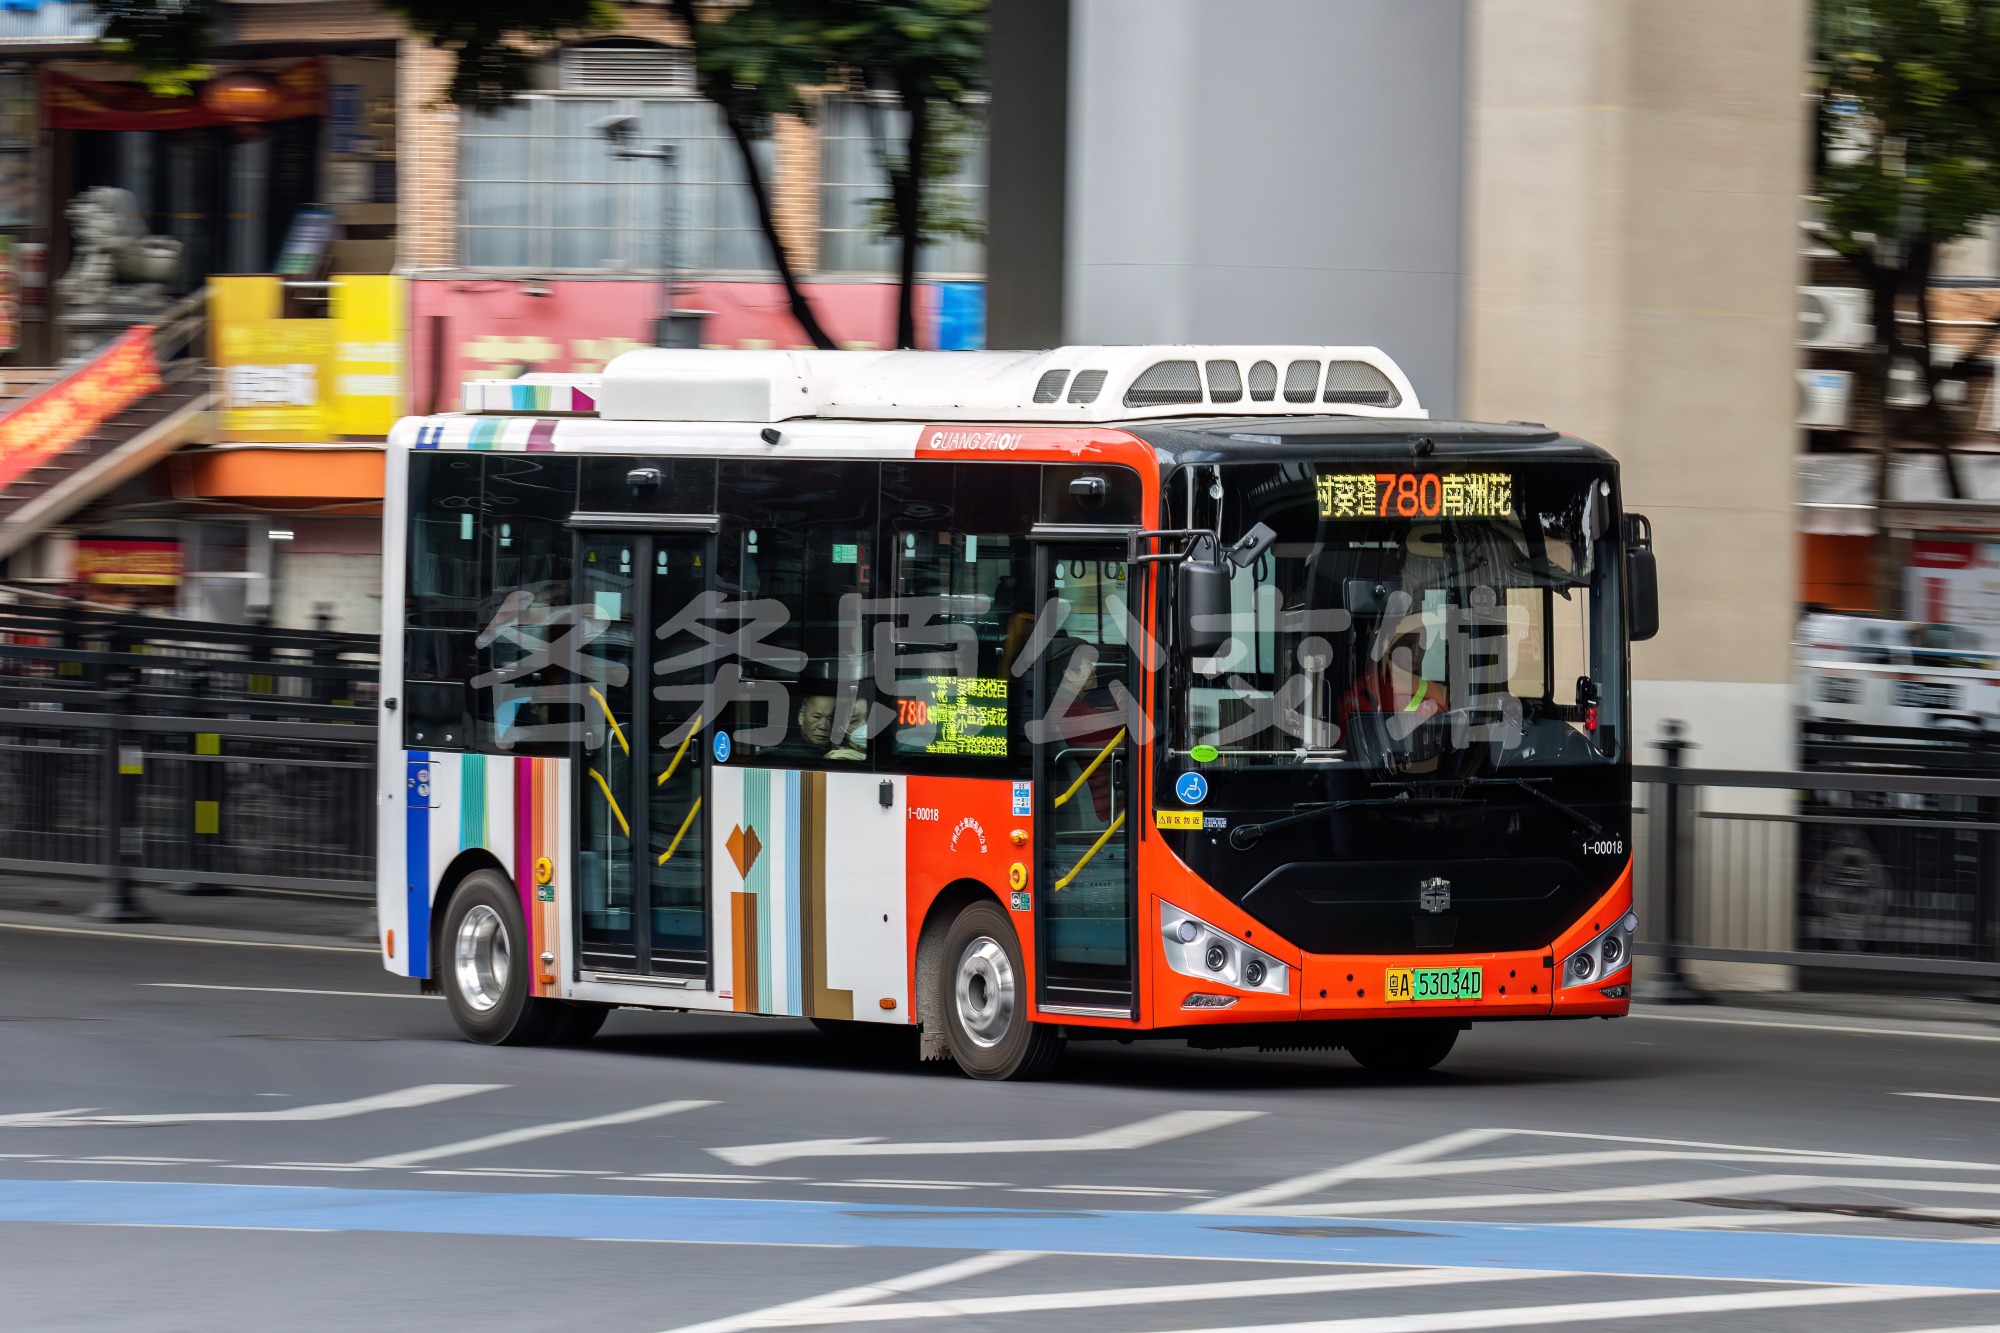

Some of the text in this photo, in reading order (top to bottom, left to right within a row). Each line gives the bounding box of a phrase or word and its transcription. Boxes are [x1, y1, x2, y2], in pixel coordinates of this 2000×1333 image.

[930, 432, 1022, 451] GUANGZHOU
[1375, 473, 1441, 517] 780
[1441, 473, 1512, 516] 南洲花
[897, 699, 927, 726] 780
[908, 807, 939, 821] 1-00018
[1582, 841, 1623, 855] 1-00018
[1389, 971, 1481, 997] 粤A 53034D
